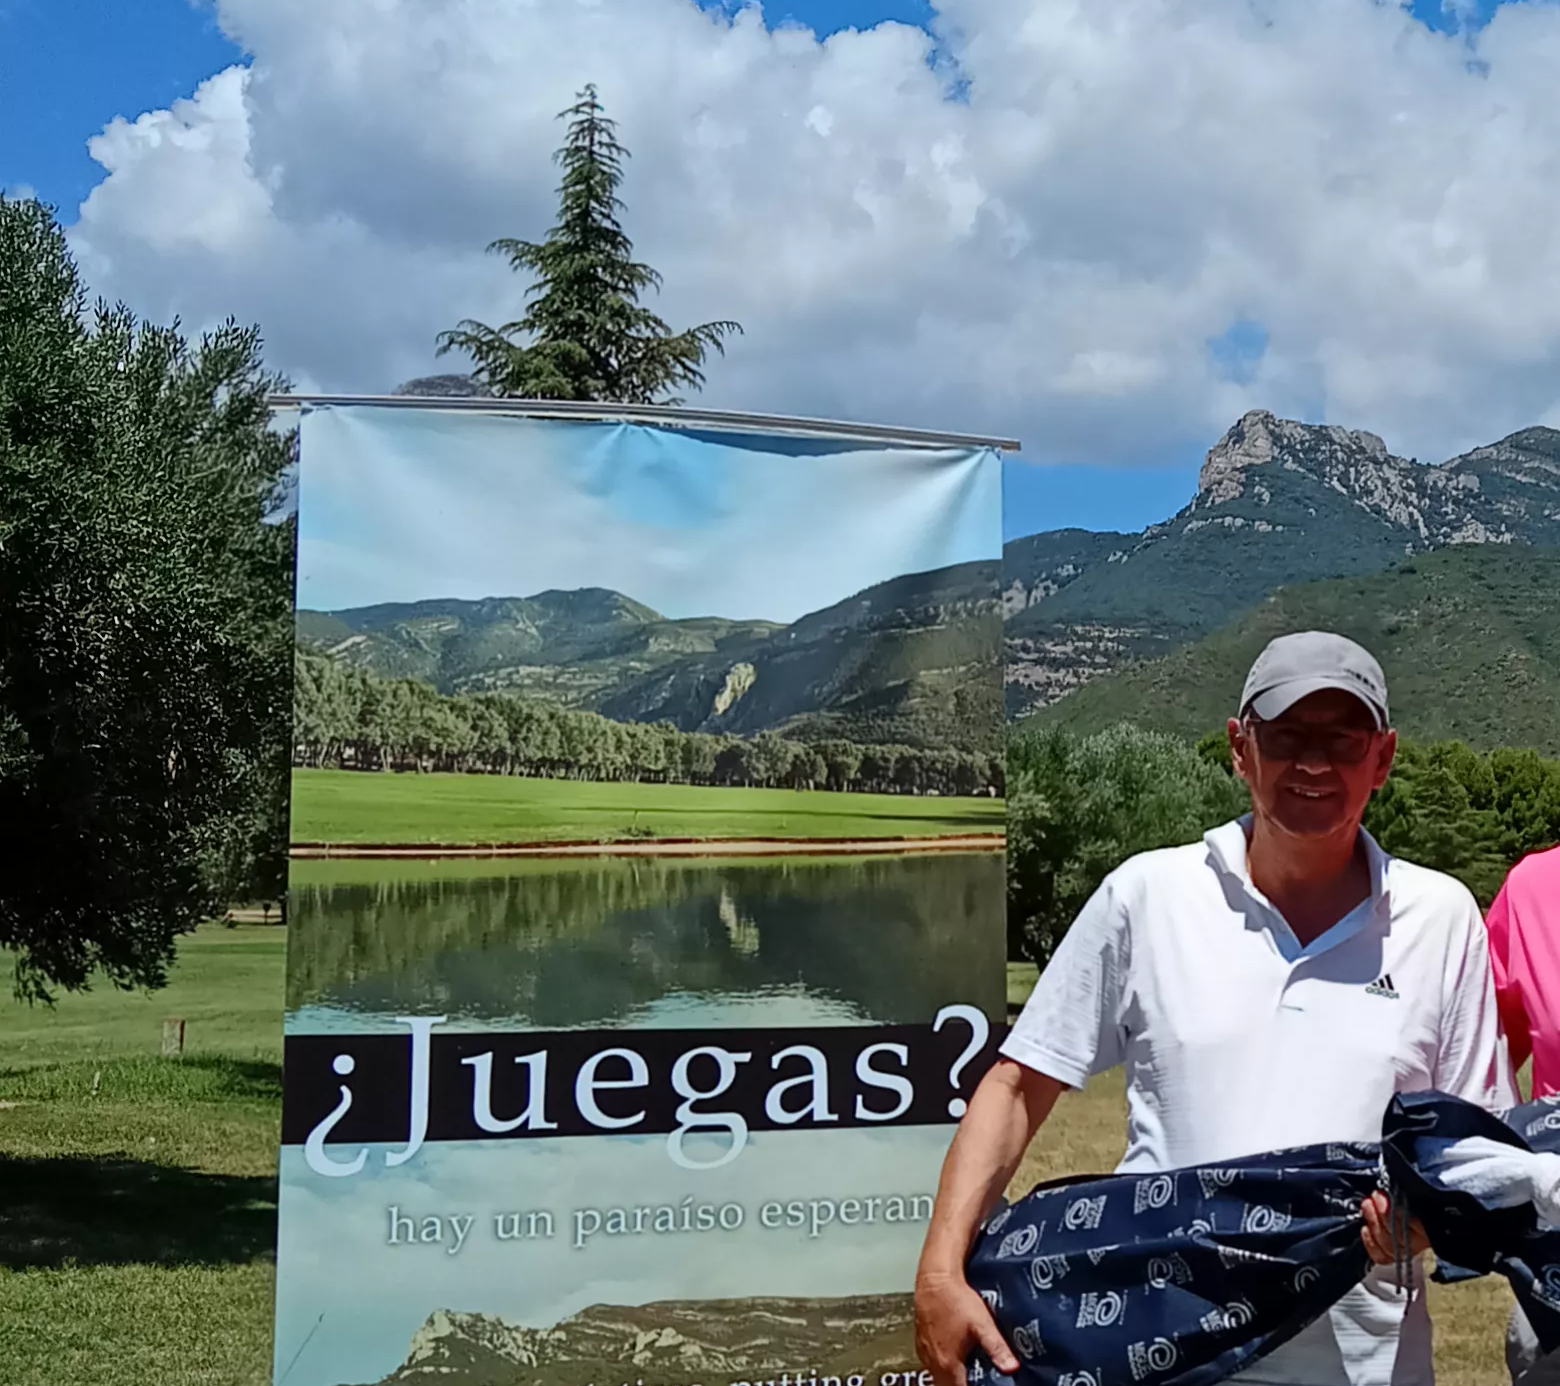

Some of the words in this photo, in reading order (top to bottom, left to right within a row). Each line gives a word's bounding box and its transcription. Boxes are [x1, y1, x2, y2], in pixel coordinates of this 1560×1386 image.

[304, 1004, 991, 1178] ¿Juegas?
[387, 1205, 474, 1255] hay
[494, 1210, 556, 1240] un
[572, 1196, 744, 1249] paraíso
[760, 1193, 935, 1238] esperan
